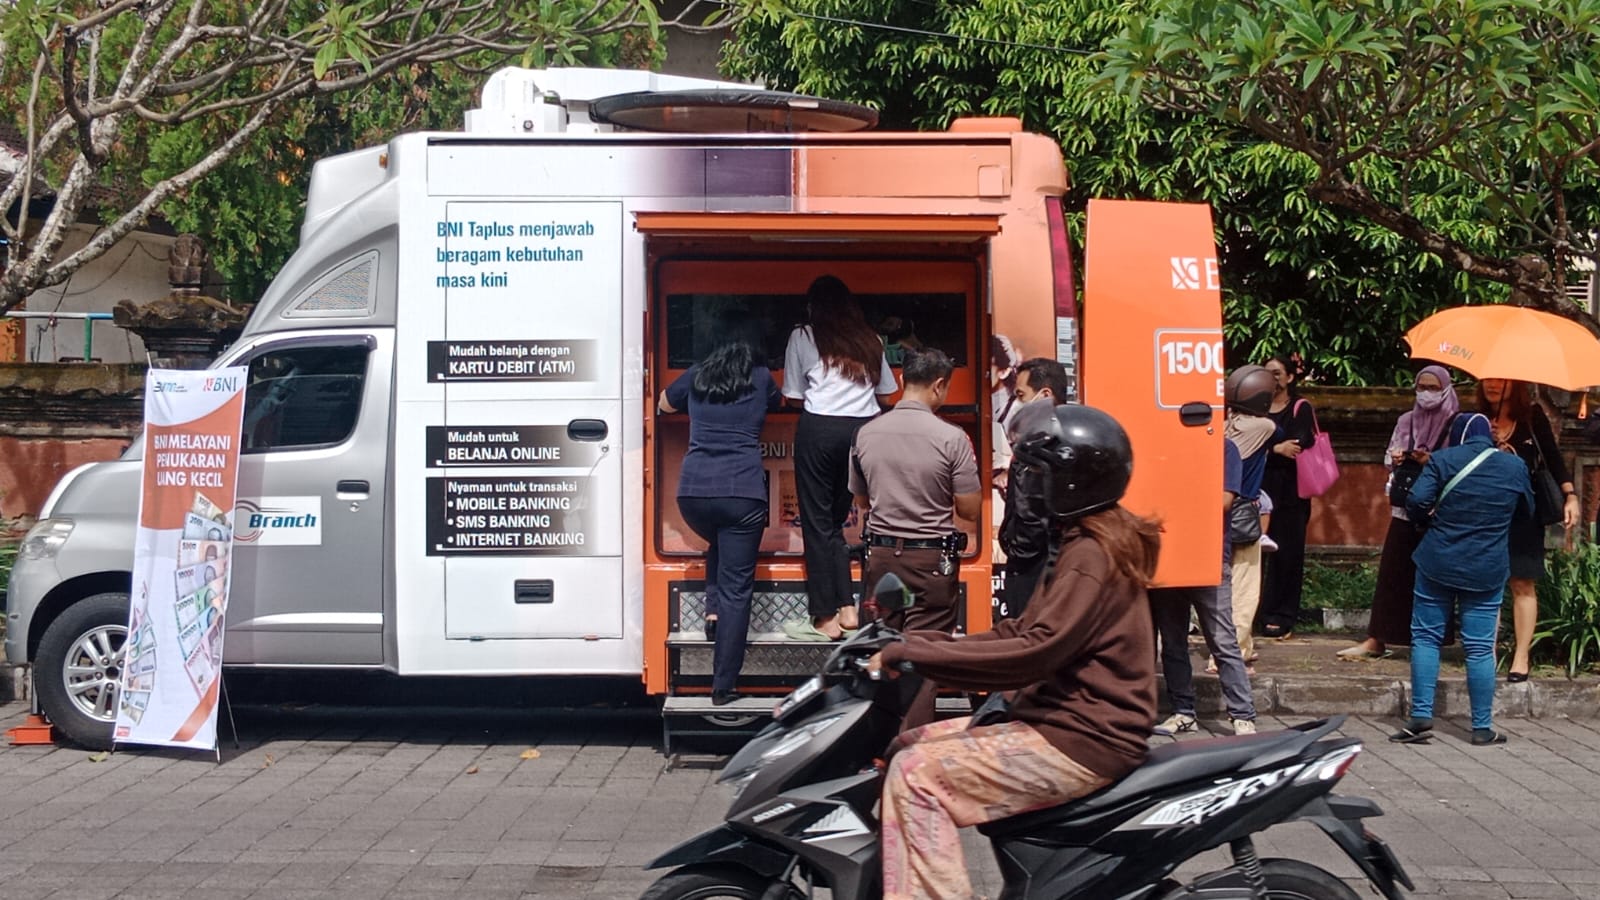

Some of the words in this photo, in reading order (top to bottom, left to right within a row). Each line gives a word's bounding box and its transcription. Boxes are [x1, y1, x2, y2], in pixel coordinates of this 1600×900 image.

[437, 221, 463, 237] BNI
[468, 221, 514, 240] Taplus
[519, 220, 594, 240] menjawab
[436, 247, 501, 265] beragam
[506, 247, 584, 262] kebutuhan
[436, 273, 476, 288] masa
[481, 272, 508, 287] kini
[449, 346, 487, 357] Mudah
[489, 345, 528, 358] belanja
[530, 345, 570, 358] dengan
[1450, 345, 1474, 360] BNI
[450, 361, 494, 374] KARTU
[497, 361, 535, 373] DEBIT
[538, 360, 575, 374] (ATM)
[213, 377, 237, 392] BNI
[168, 434, 231, 450] MELAYANI
[448, 432, 485, 442] Mudah
[488, 431, 519, 442] untuk
[448, 448, 507, 460] BELANJA
[511, 447, 560, 460] ONLINE
[190, 472, 223, 487] KECIL
[448, 482, 493, 494] Nyaman
[495, 482, 526, 492] untuk
[529, 482, 578, 492] transaksi
[456, 498, 506, 510] MOBILE
[509, 497, 570, 510] BANKING
[249, 514, 317, 528] Branch
[456, 515, 486, 528] SMS
[489, 515, 550, 528] BANKING
[456, 533, 520, 546] INTERNET
[524, 532, 585, 545] BANKING
